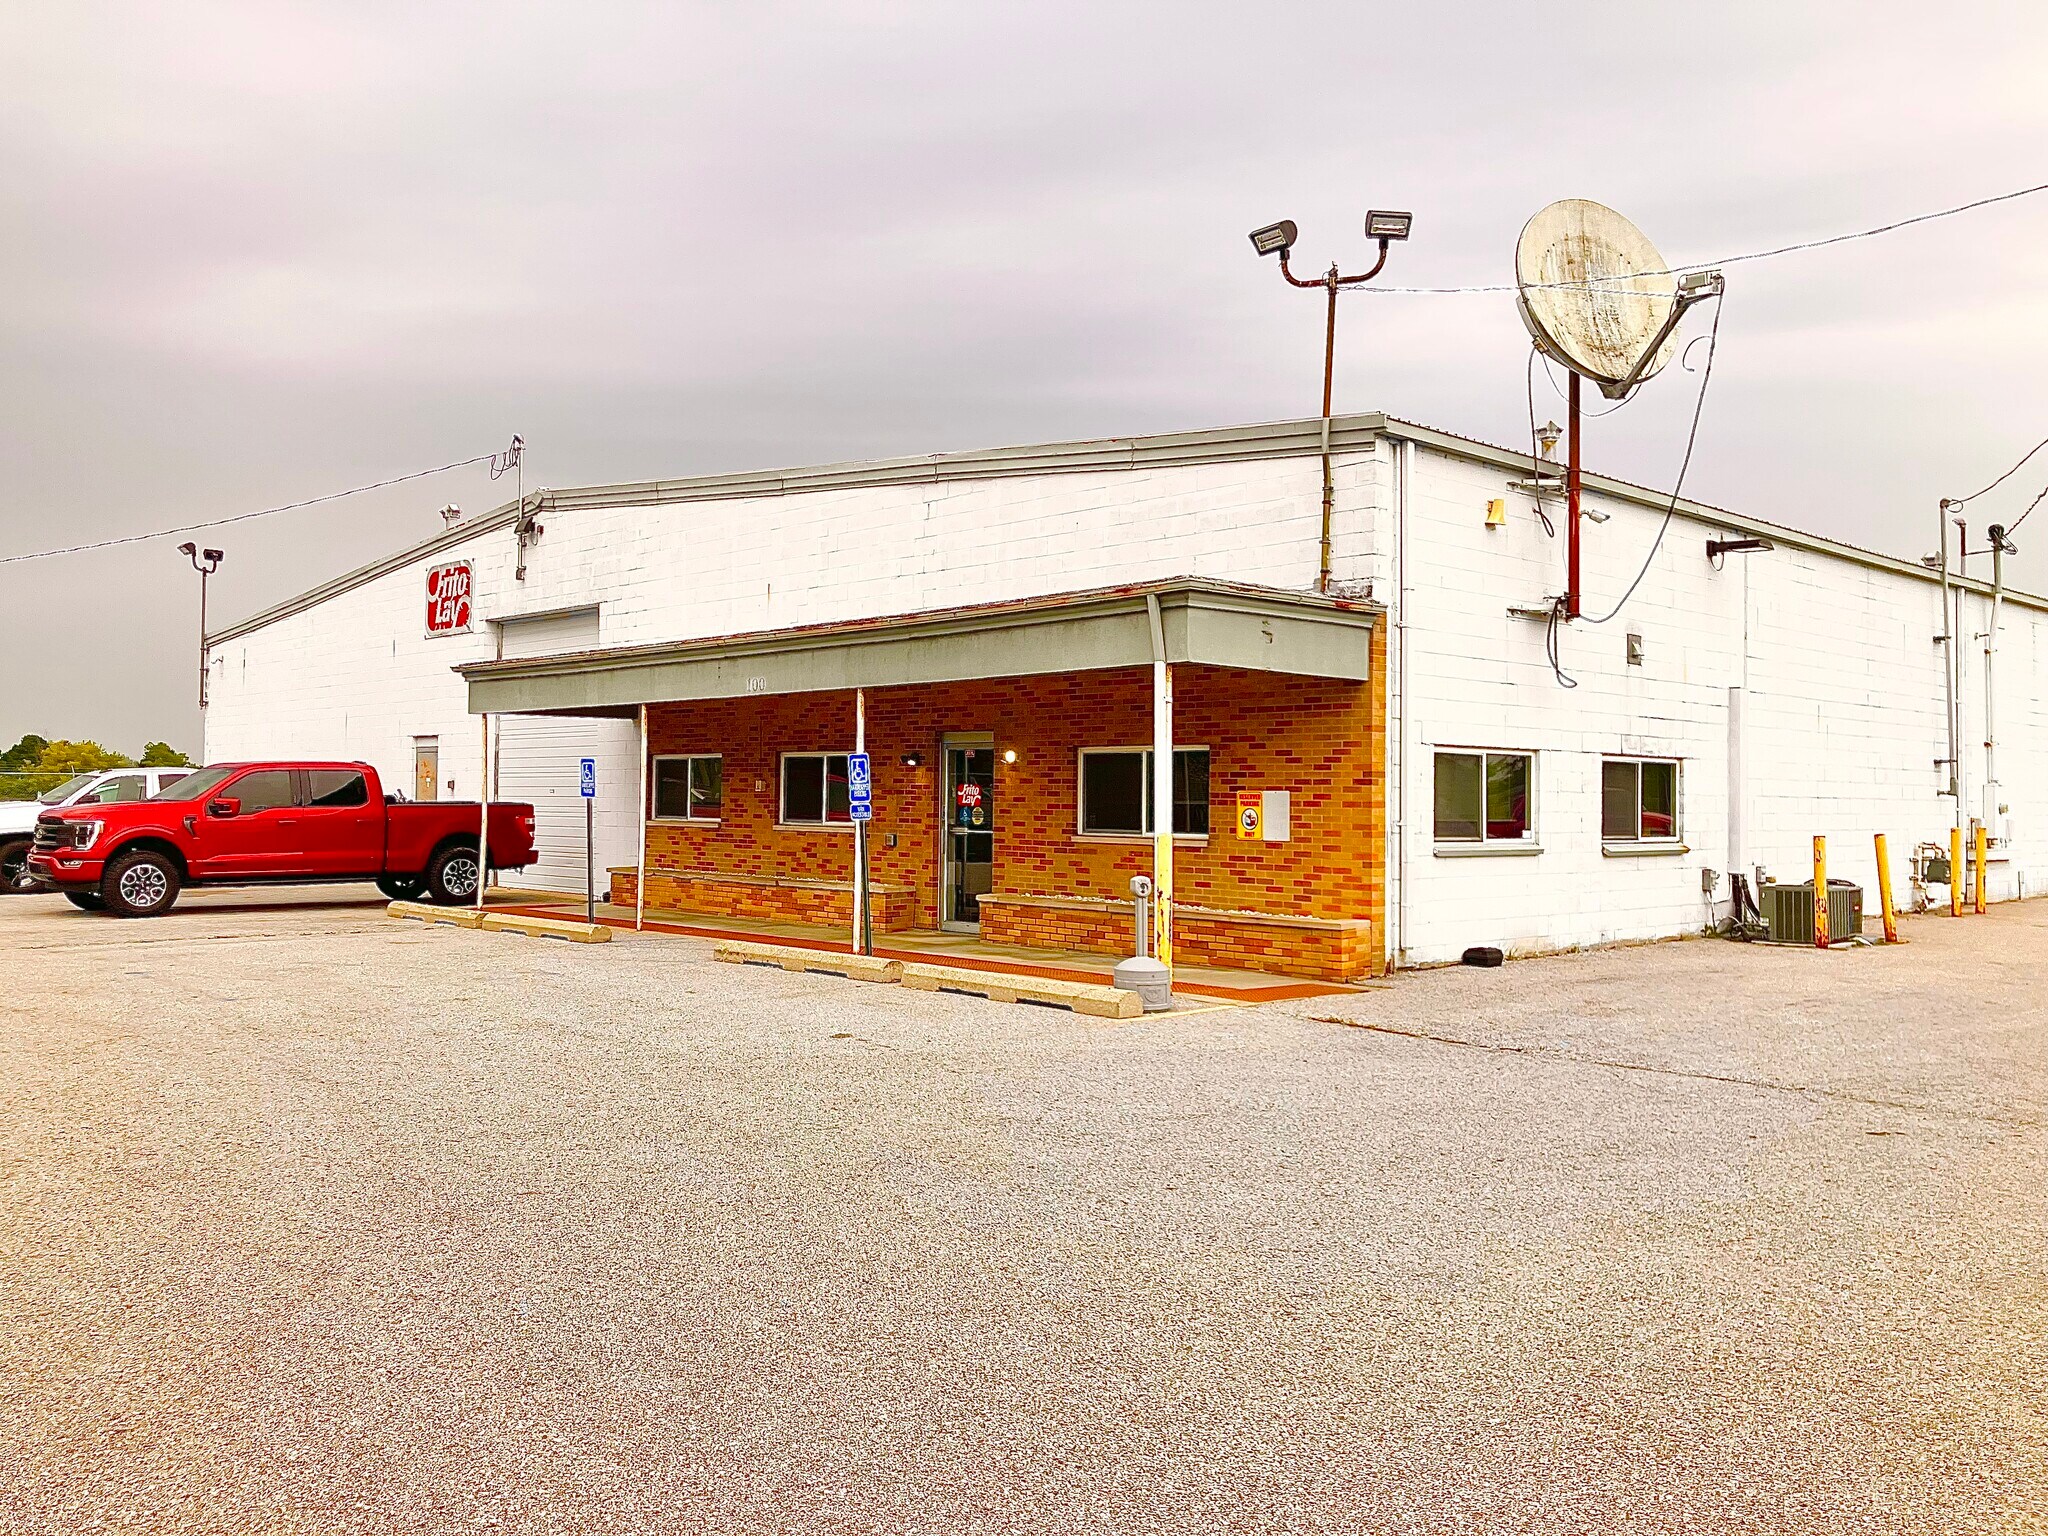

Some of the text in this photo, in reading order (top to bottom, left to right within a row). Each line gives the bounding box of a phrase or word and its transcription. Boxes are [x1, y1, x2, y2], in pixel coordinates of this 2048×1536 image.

[428, 566, 469, 602] Frito
[435, 594, 471, 627] Lay
[747, 677, 766, 692] 100
[957, 784, 980, 796] Frito
[962, 794, 982, 807] Lay
